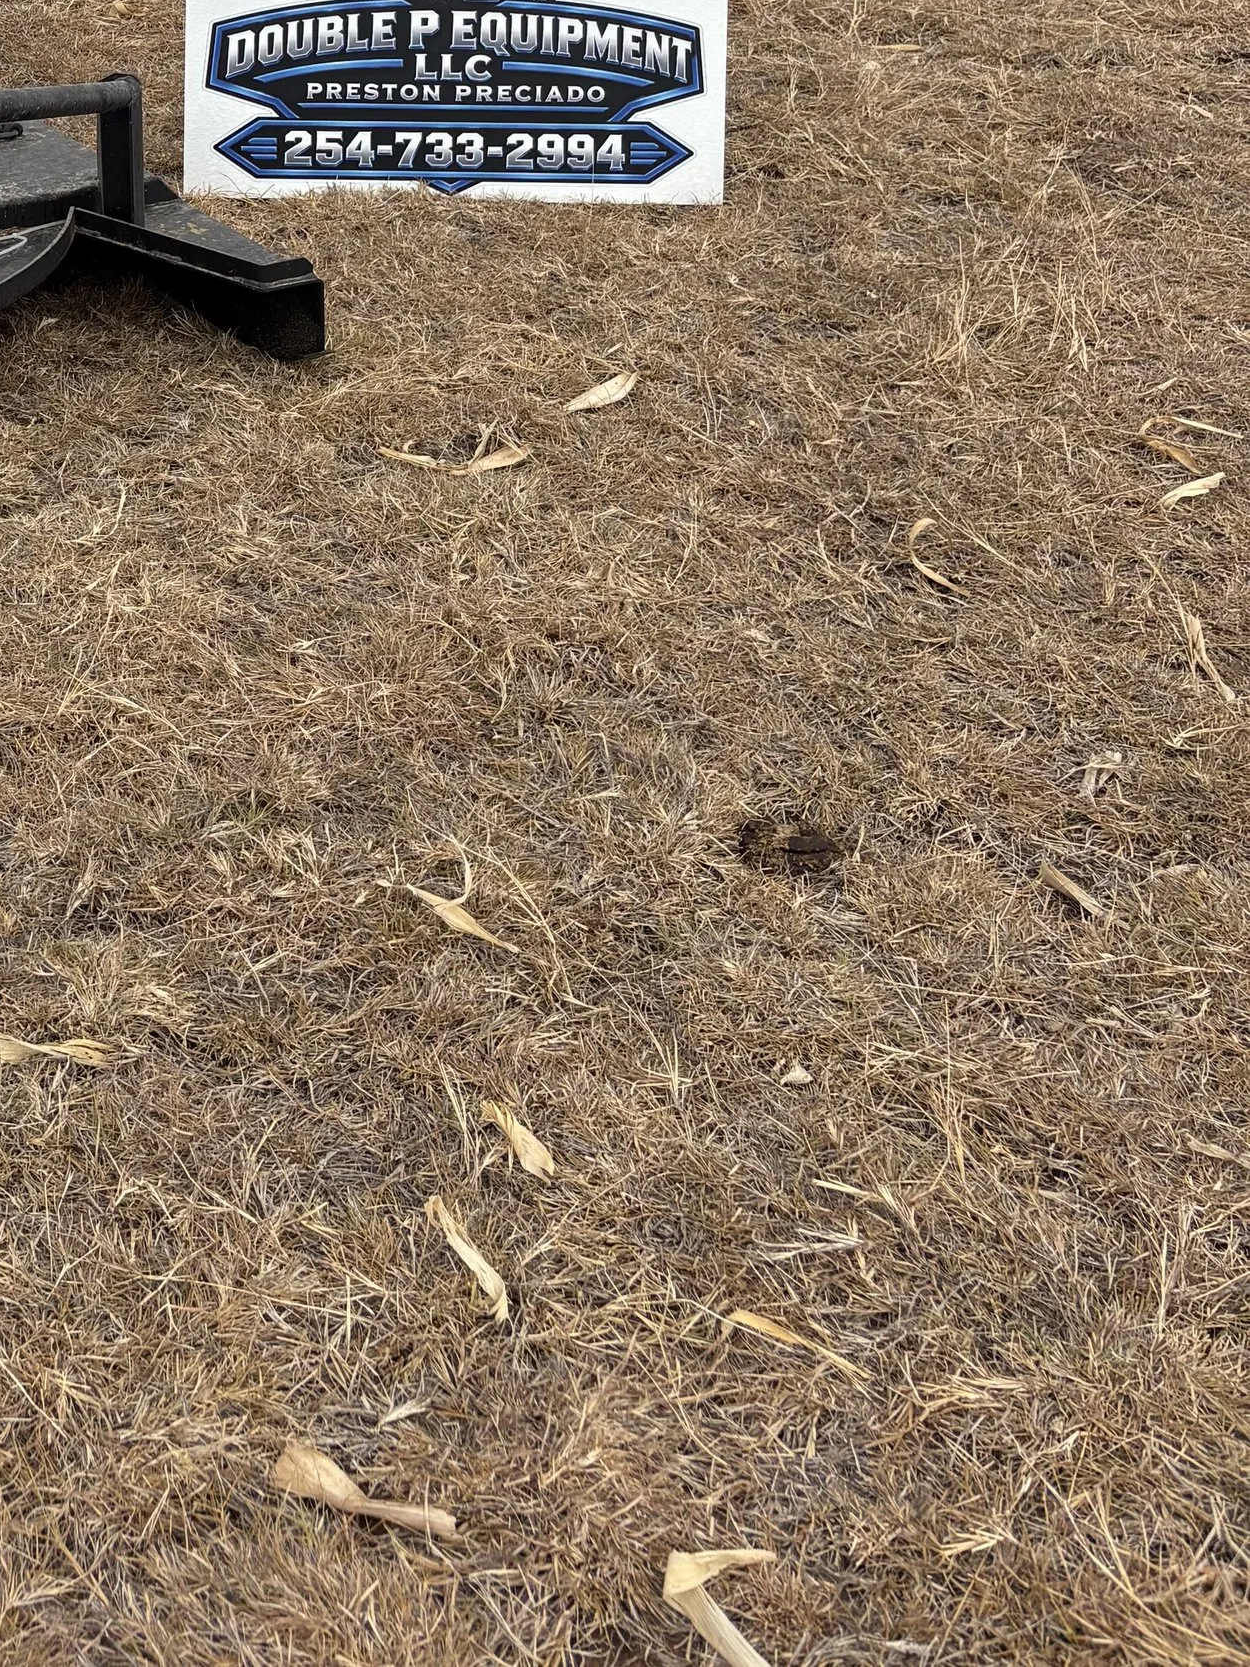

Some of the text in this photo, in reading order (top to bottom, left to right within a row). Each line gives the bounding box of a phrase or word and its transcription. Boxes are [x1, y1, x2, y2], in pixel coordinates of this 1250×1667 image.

[224, 10, 693, 84] DOUBLE P EQUIPMENT
[414, 54, 493, 82] LLC
[306, 82, 607, 104] PRESTON PRECIADO
[282, 130, 626, 171] 254-733-2994
